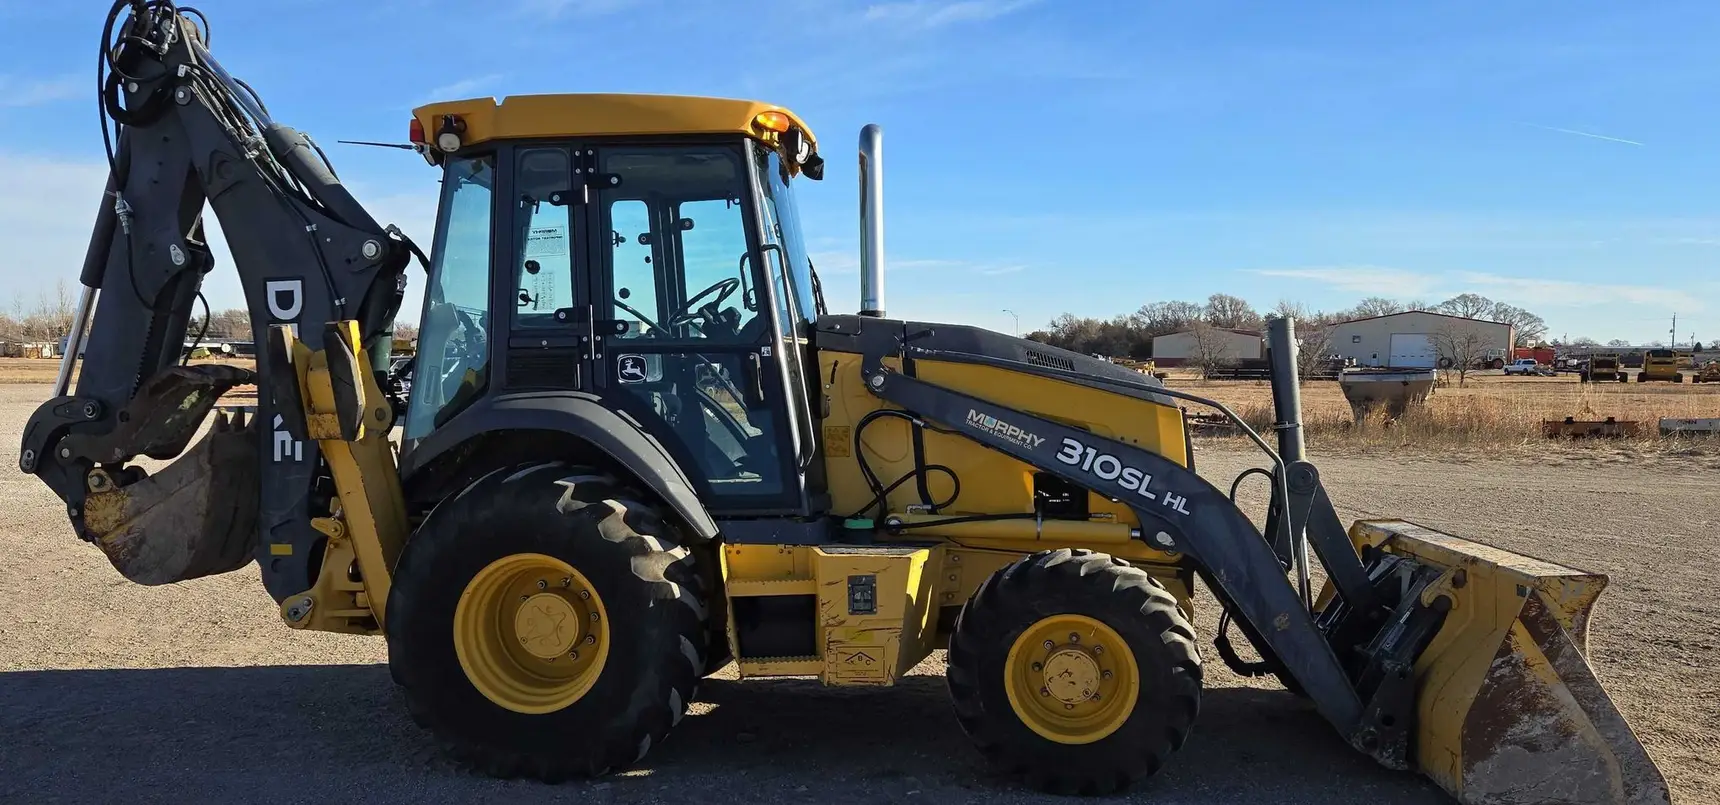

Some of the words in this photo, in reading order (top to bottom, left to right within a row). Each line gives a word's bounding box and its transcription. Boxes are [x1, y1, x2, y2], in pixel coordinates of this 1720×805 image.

[965, 419, 989, 433] TRACTOR
[994, 431, 1023, 447] EQUIPMENT
[1023, 443, 1033, 451] CO.
[967, 409, 1046, 447] MURPHY
[1056, 438, 1157, 500] 310SL
[1162, 491, 1191, 515] HL
